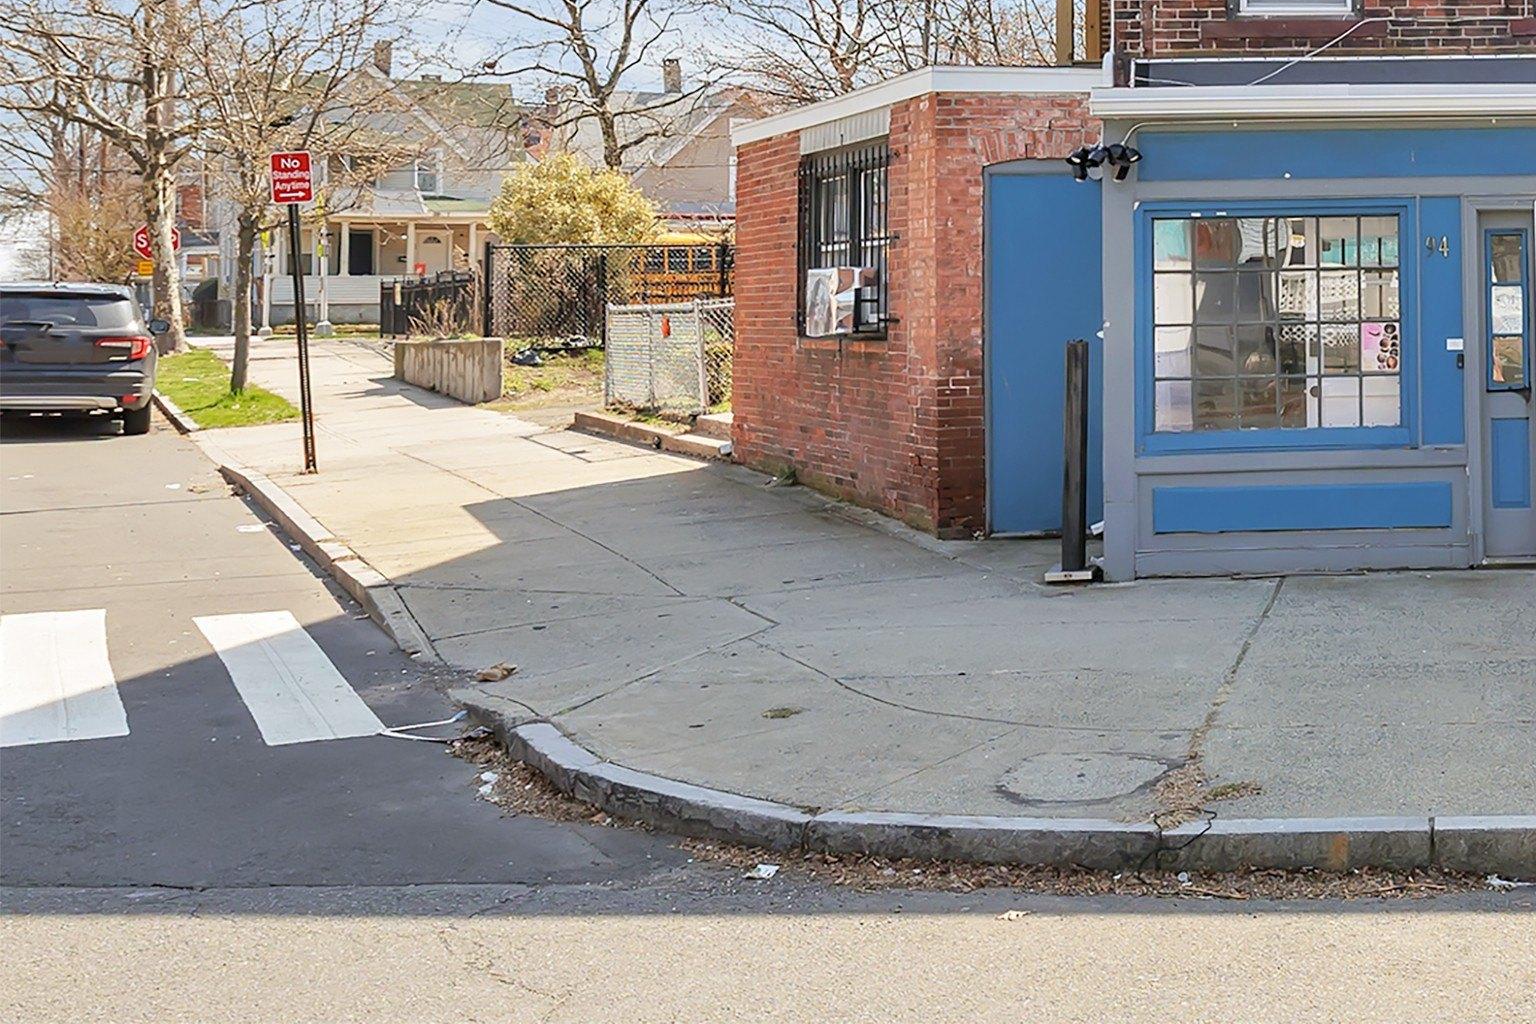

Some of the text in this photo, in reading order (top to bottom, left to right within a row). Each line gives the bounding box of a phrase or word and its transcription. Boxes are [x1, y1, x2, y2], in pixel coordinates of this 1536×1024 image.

[281, 158, 300, 169] No
[272, 170, 310, 180] Standing
[274, 181, 310, 192] Anytime
[1425, 235, 1450, 258] 94
